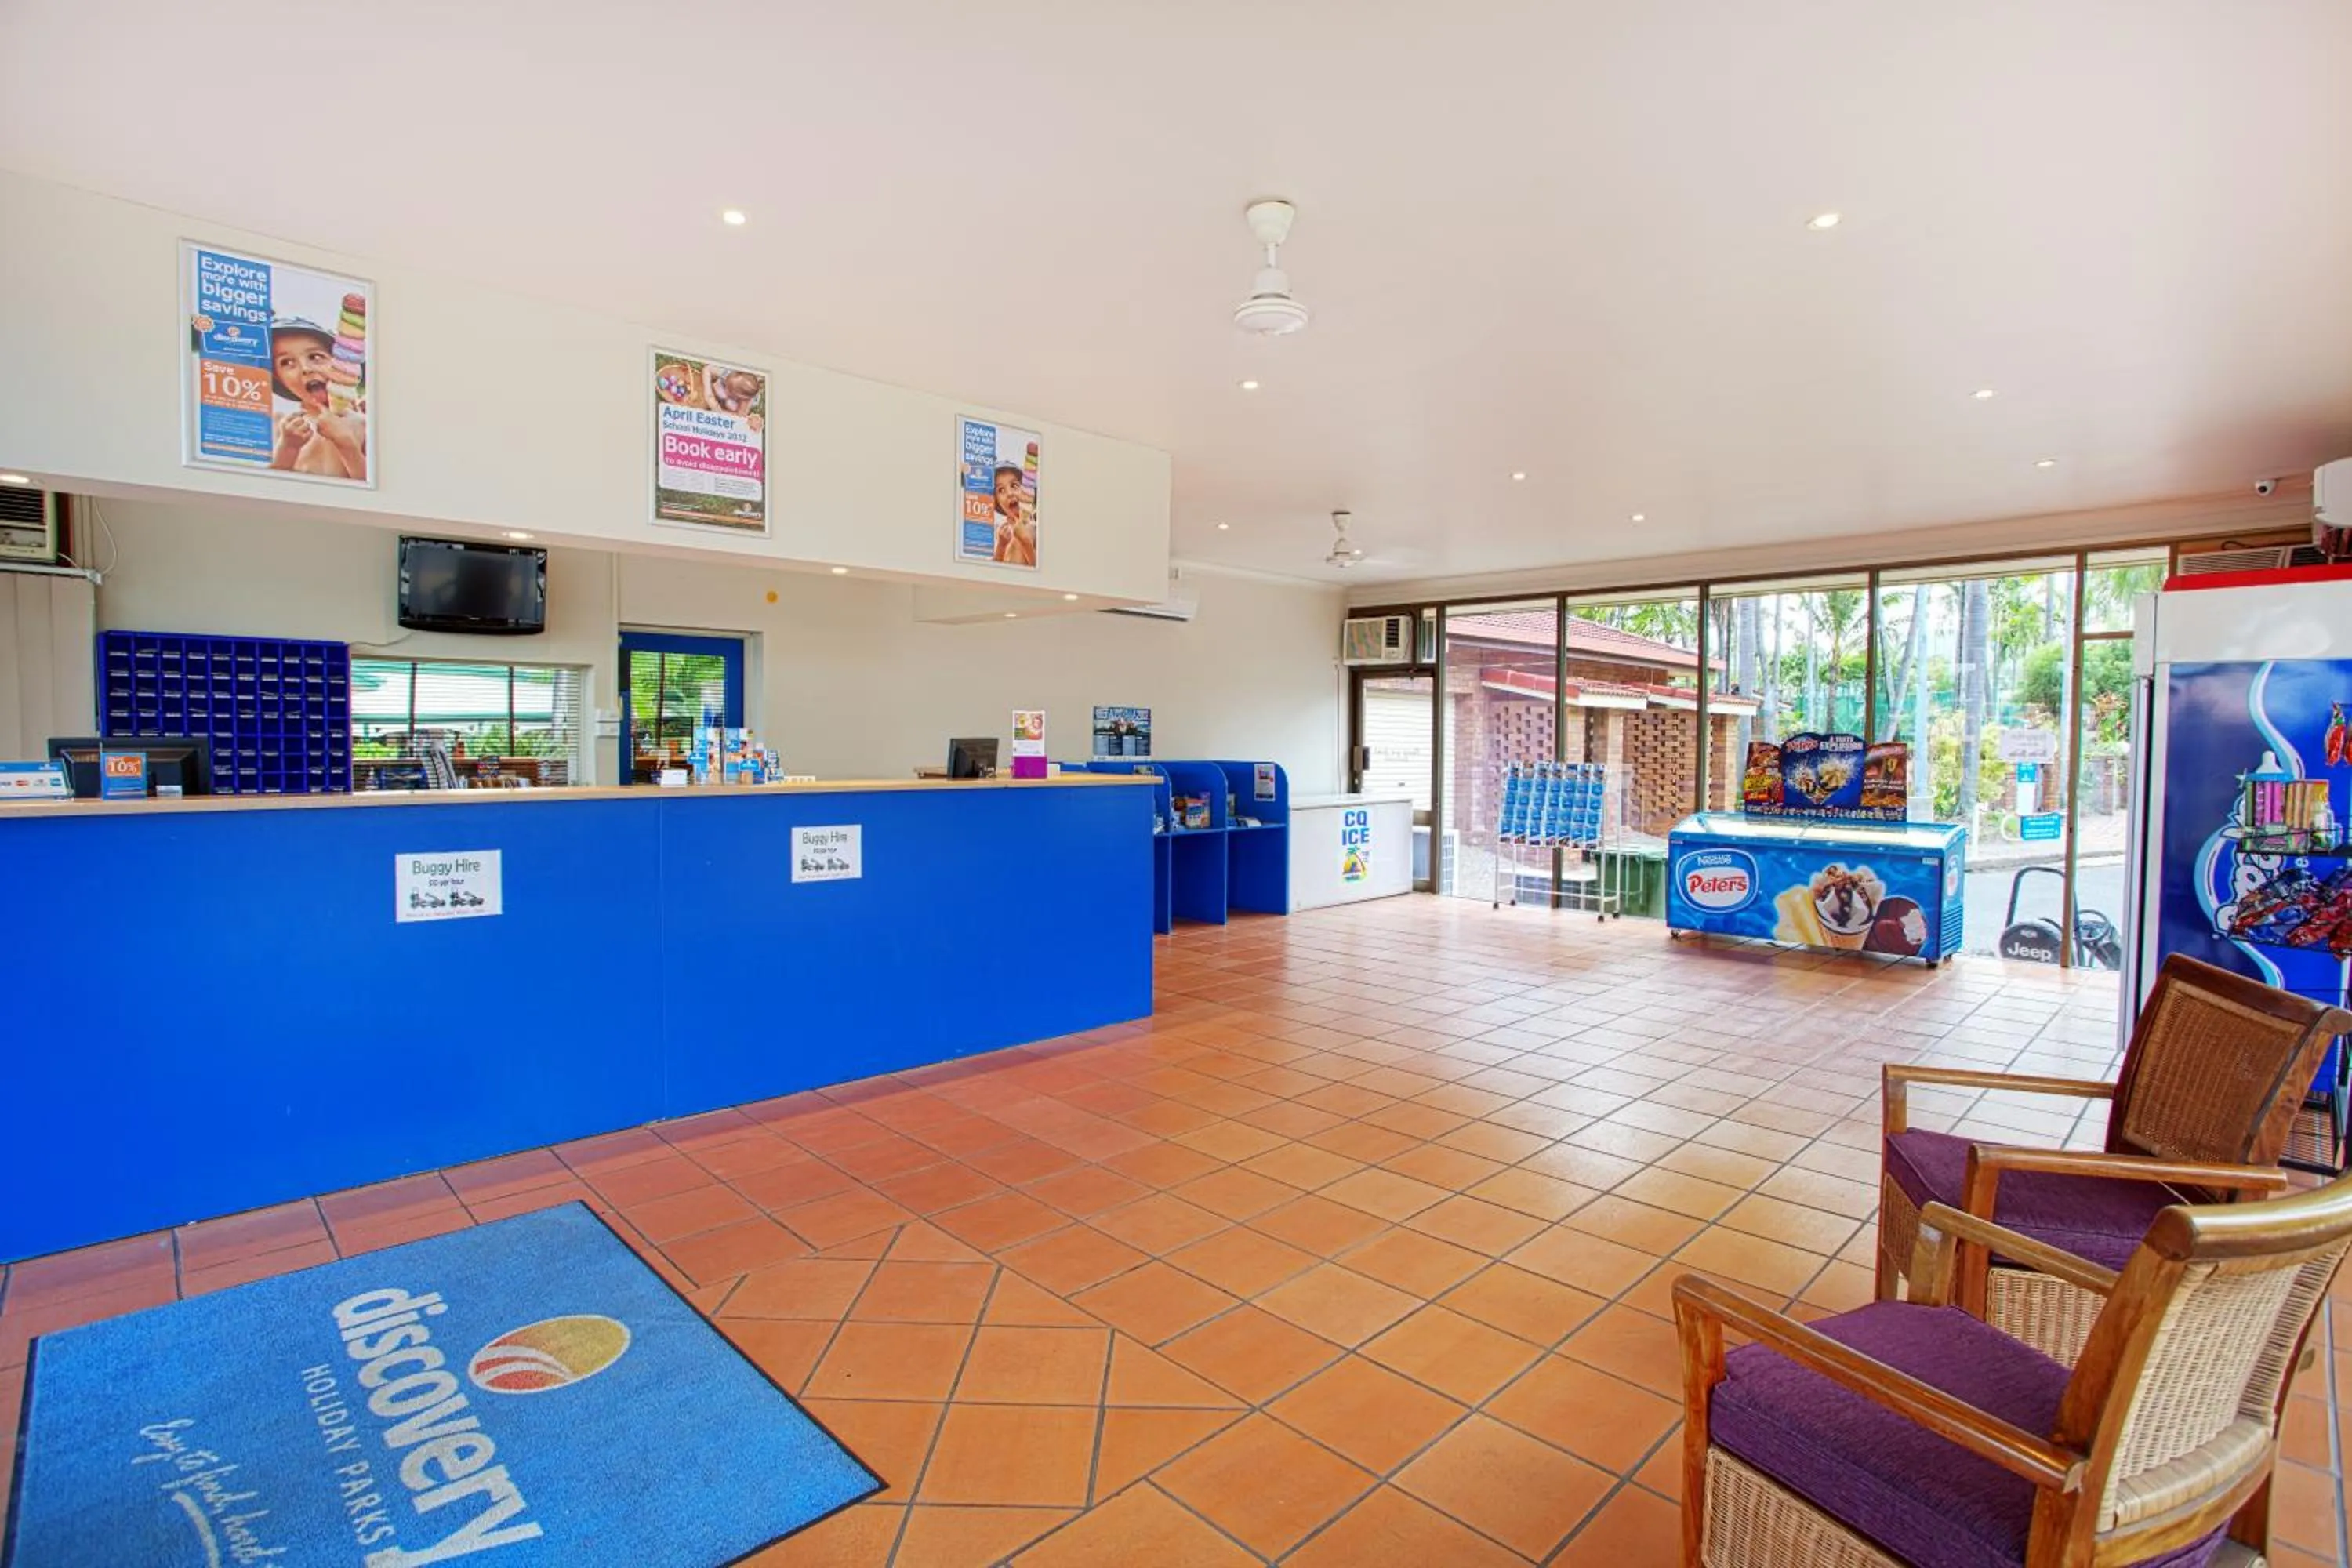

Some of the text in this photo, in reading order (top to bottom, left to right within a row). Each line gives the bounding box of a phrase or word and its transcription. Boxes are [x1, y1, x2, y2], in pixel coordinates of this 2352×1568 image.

[201, 256, 267, 281] Explore
[201, 271, 267, 292] more with
[202, 280, 267, 306] bigger
[201, 299, 267, 322] savings
[204, 361, 234, 375] Save
[664, 406, 735, 429] April Easter
[664, 421, 690, 431] School
[693, 426, 725, 439] Holidays
[666, 436, 757, 469] Book early
[1342, 828, 1370, 845] ICE
[413, 858, 480, 876] Buggy Hire
[1687, 874, 1748, 893] Peters
[2007, 942, 2052, 962] Jeep
[332, 1289, 544, 1568] discovery
[303, 1364, 394, 1545] HOLIDAY PARKS
